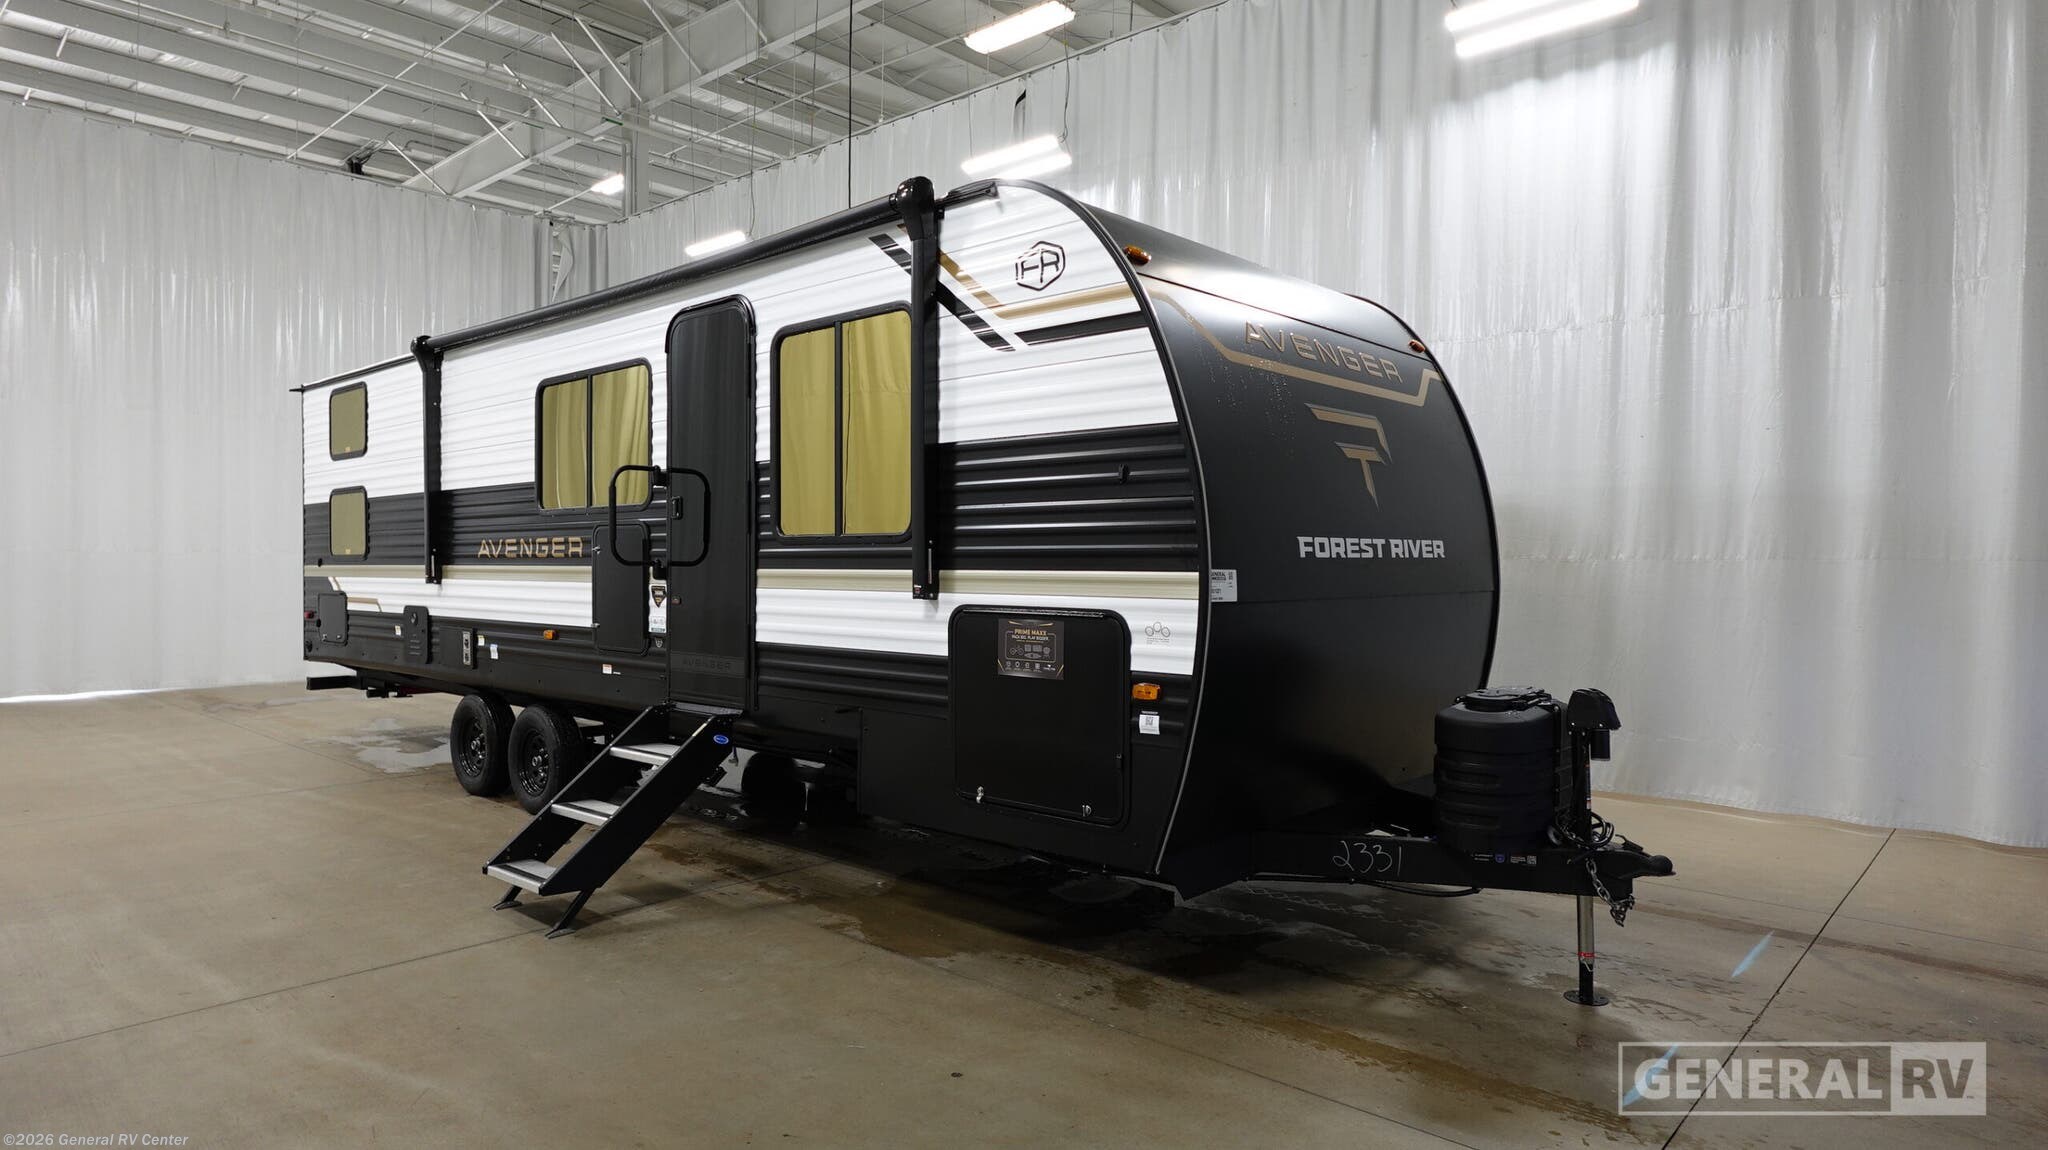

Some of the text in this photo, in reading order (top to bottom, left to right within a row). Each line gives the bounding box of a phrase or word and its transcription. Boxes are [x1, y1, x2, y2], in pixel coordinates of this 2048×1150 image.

[1245, 321, 1403, 384] AVENGER
[477, 536, 583, 559] AVENGER
[1297, 536, 1446, 559] FOREST RIVER
[1332, 840, 1402, 877] 2331
